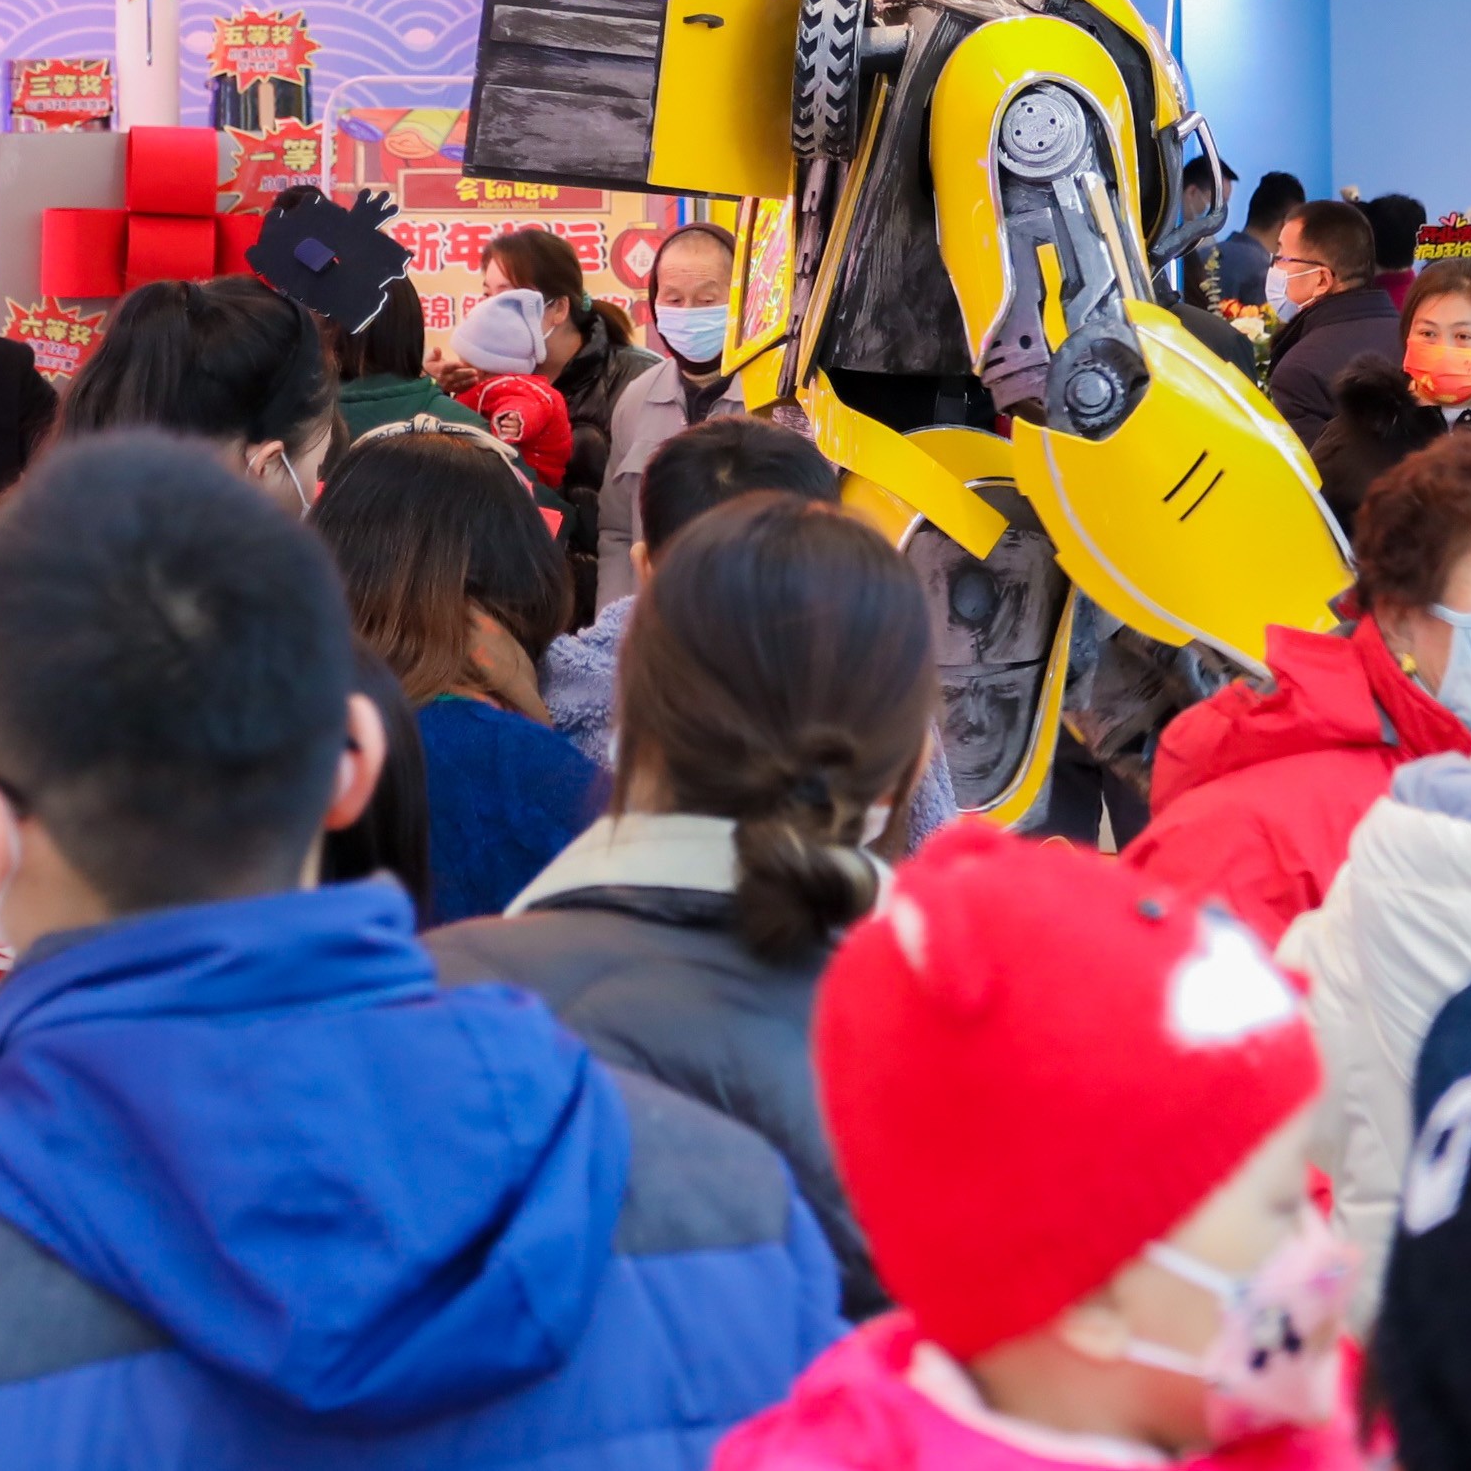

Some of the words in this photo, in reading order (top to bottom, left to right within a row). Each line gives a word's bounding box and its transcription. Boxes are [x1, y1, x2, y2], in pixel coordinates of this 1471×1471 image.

[224, 25, 293, 46] 五等奖
[30, 74, 103, 97] 三等奖
[391, 220, 605, 272] 新年运
[19, 315, 92, 347] 六等奖
